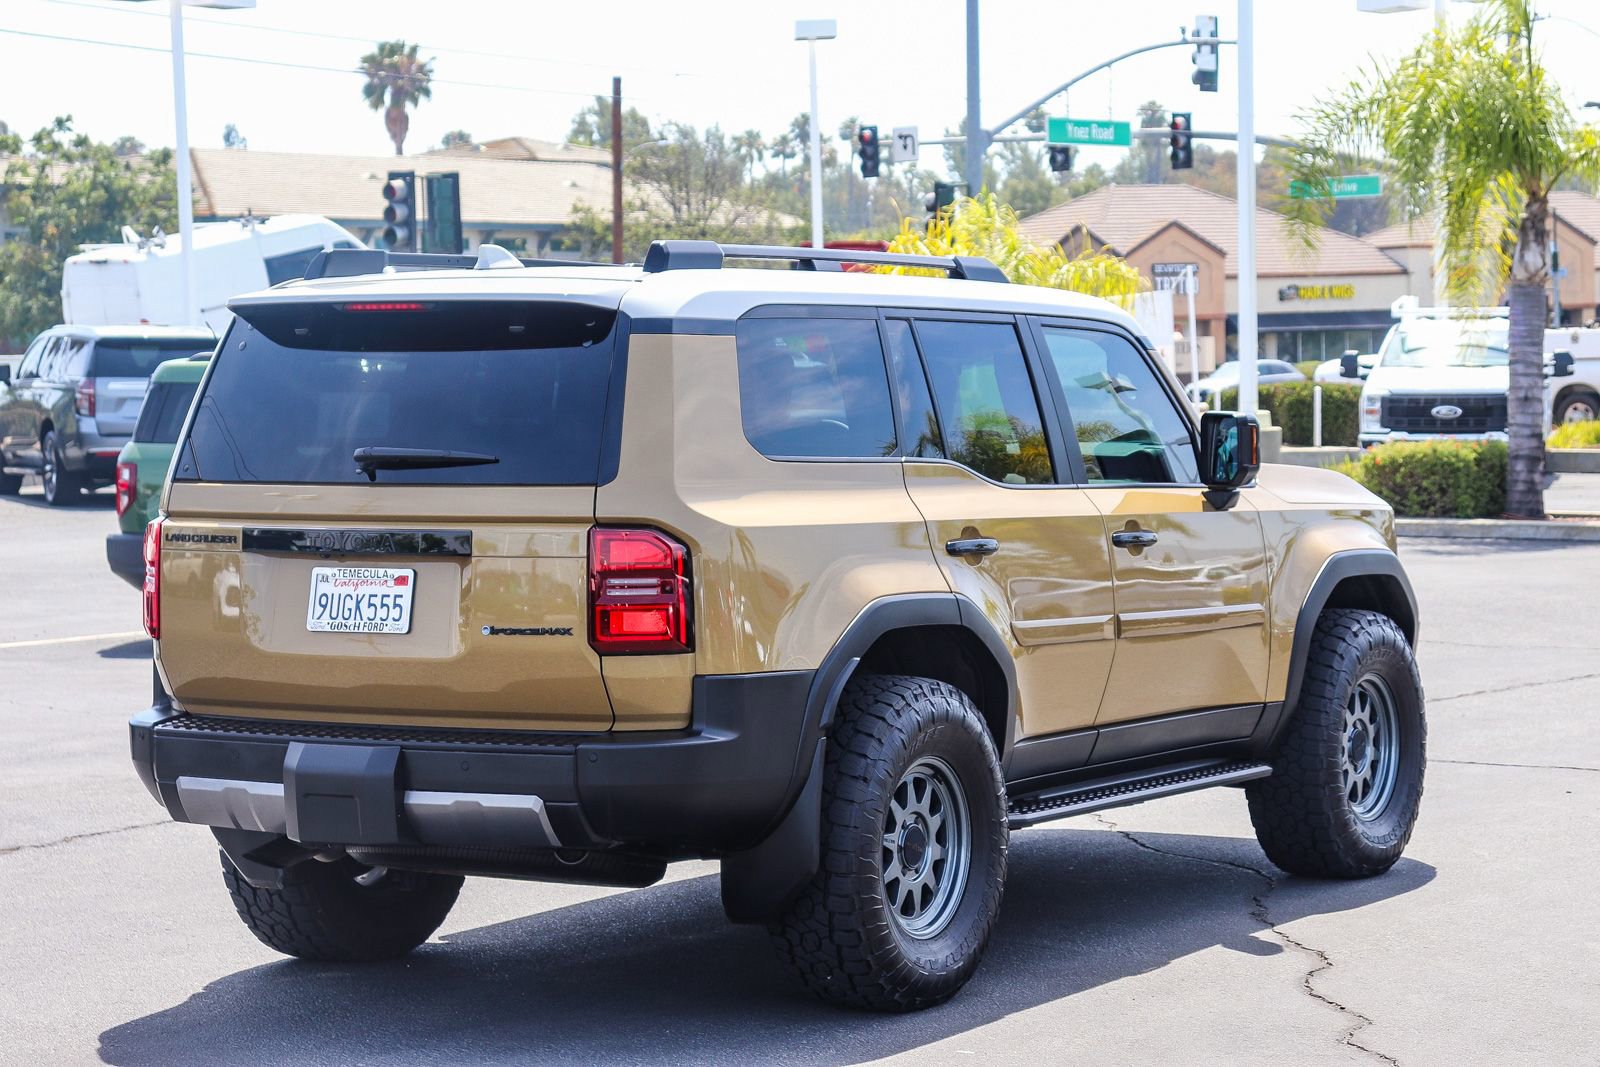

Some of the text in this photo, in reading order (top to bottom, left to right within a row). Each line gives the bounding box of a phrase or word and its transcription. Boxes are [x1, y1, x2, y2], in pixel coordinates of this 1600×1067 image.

[1066, 122, 1115, 140] Ynez Road
[1333, 182, 1358, 193] Drive
[165, 533, 237, 544] LAND CRUISER
[307, 531, 396, 552] TOYOTA
[319, 575, 330, 583] JUL
[337, 568, 389, 579] TEMECULA
[333, 579, 388, 592] California
[317, 593, 404, 622] 9UGK555
[362, 621, 385, 632] FORD
[541, 627, 574, 636] MAX
